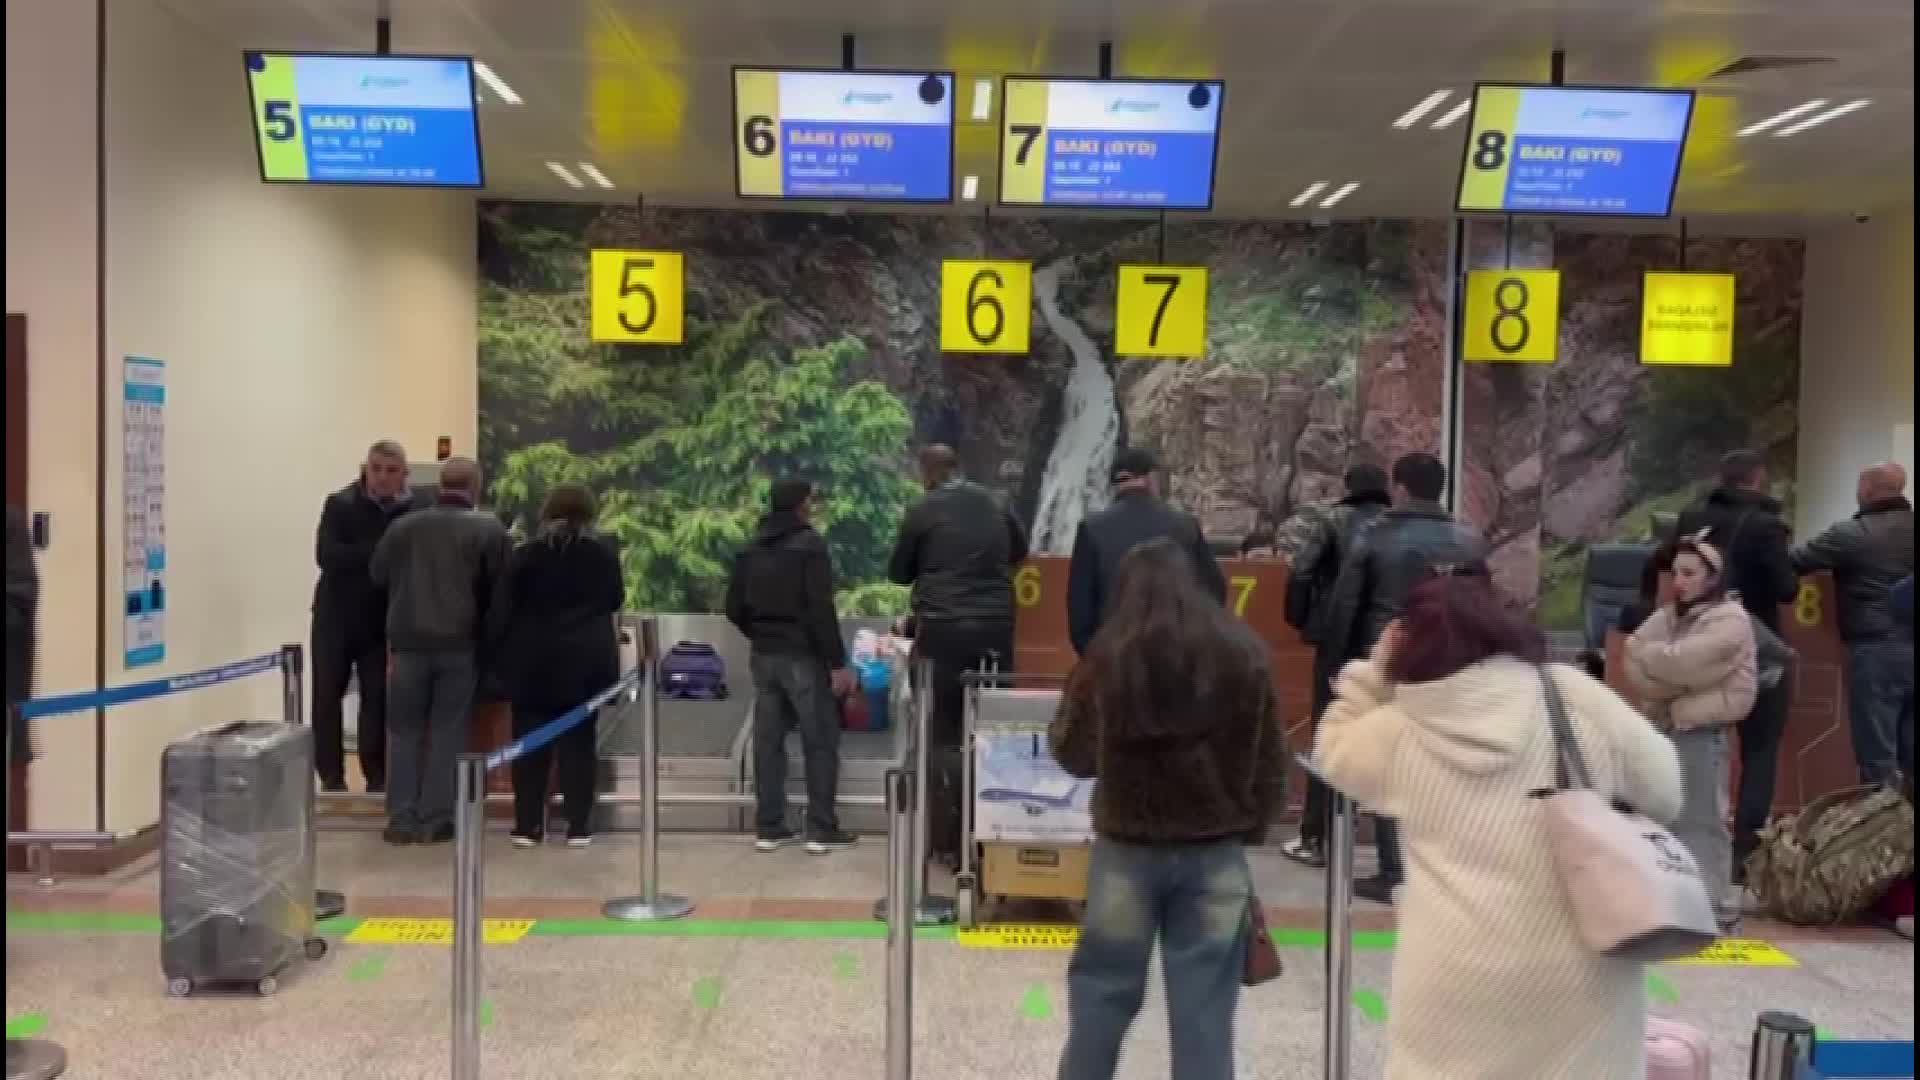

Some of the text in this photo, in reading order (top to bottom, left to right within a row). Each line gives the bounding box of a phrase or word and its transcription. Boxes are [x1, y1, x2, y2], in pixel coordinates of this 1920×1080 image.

[264, 101, 295, 141] 5
[744, 116, 776, 158] 6
[1010, 125, 1042, 166] 7
[1473, 130, 1506, 170] 8
[618, 258, 656, 334] 5
[967, 269, 1004, 346] 6
[1143, 273, 1181, 347] 7
[1490, 279, 1530, 353] 8
[1014, 566, 1041, 607] 6
[1230, 576, 1257, 617] 7
[1796, 584, 1822, 626] 8
